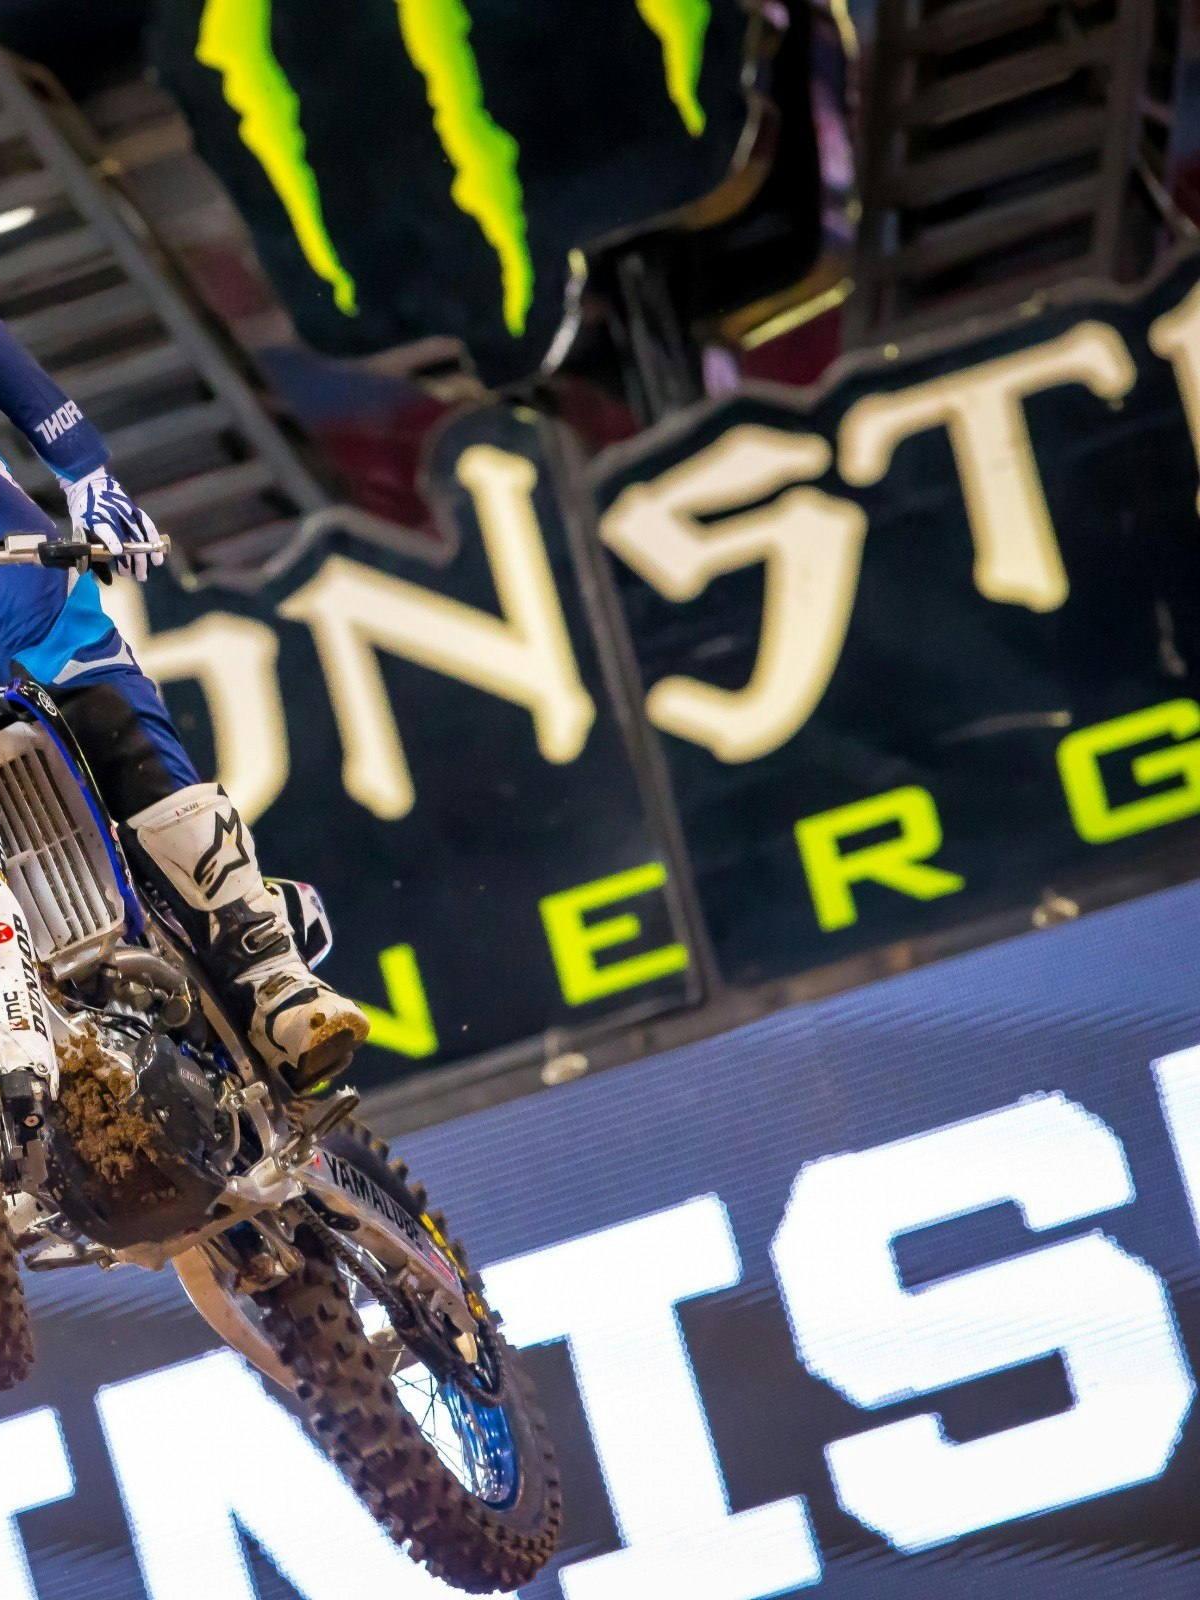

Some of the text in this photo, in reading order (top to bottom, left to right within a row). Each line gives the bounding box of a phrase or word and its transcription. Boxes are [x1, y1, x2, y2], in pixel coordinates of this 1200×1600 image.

[35, 400, 83, 444] THOR
[11, 913, 49, 1042] DUNLOP
[323, 1152, 420, 1240] YAMALUBE
